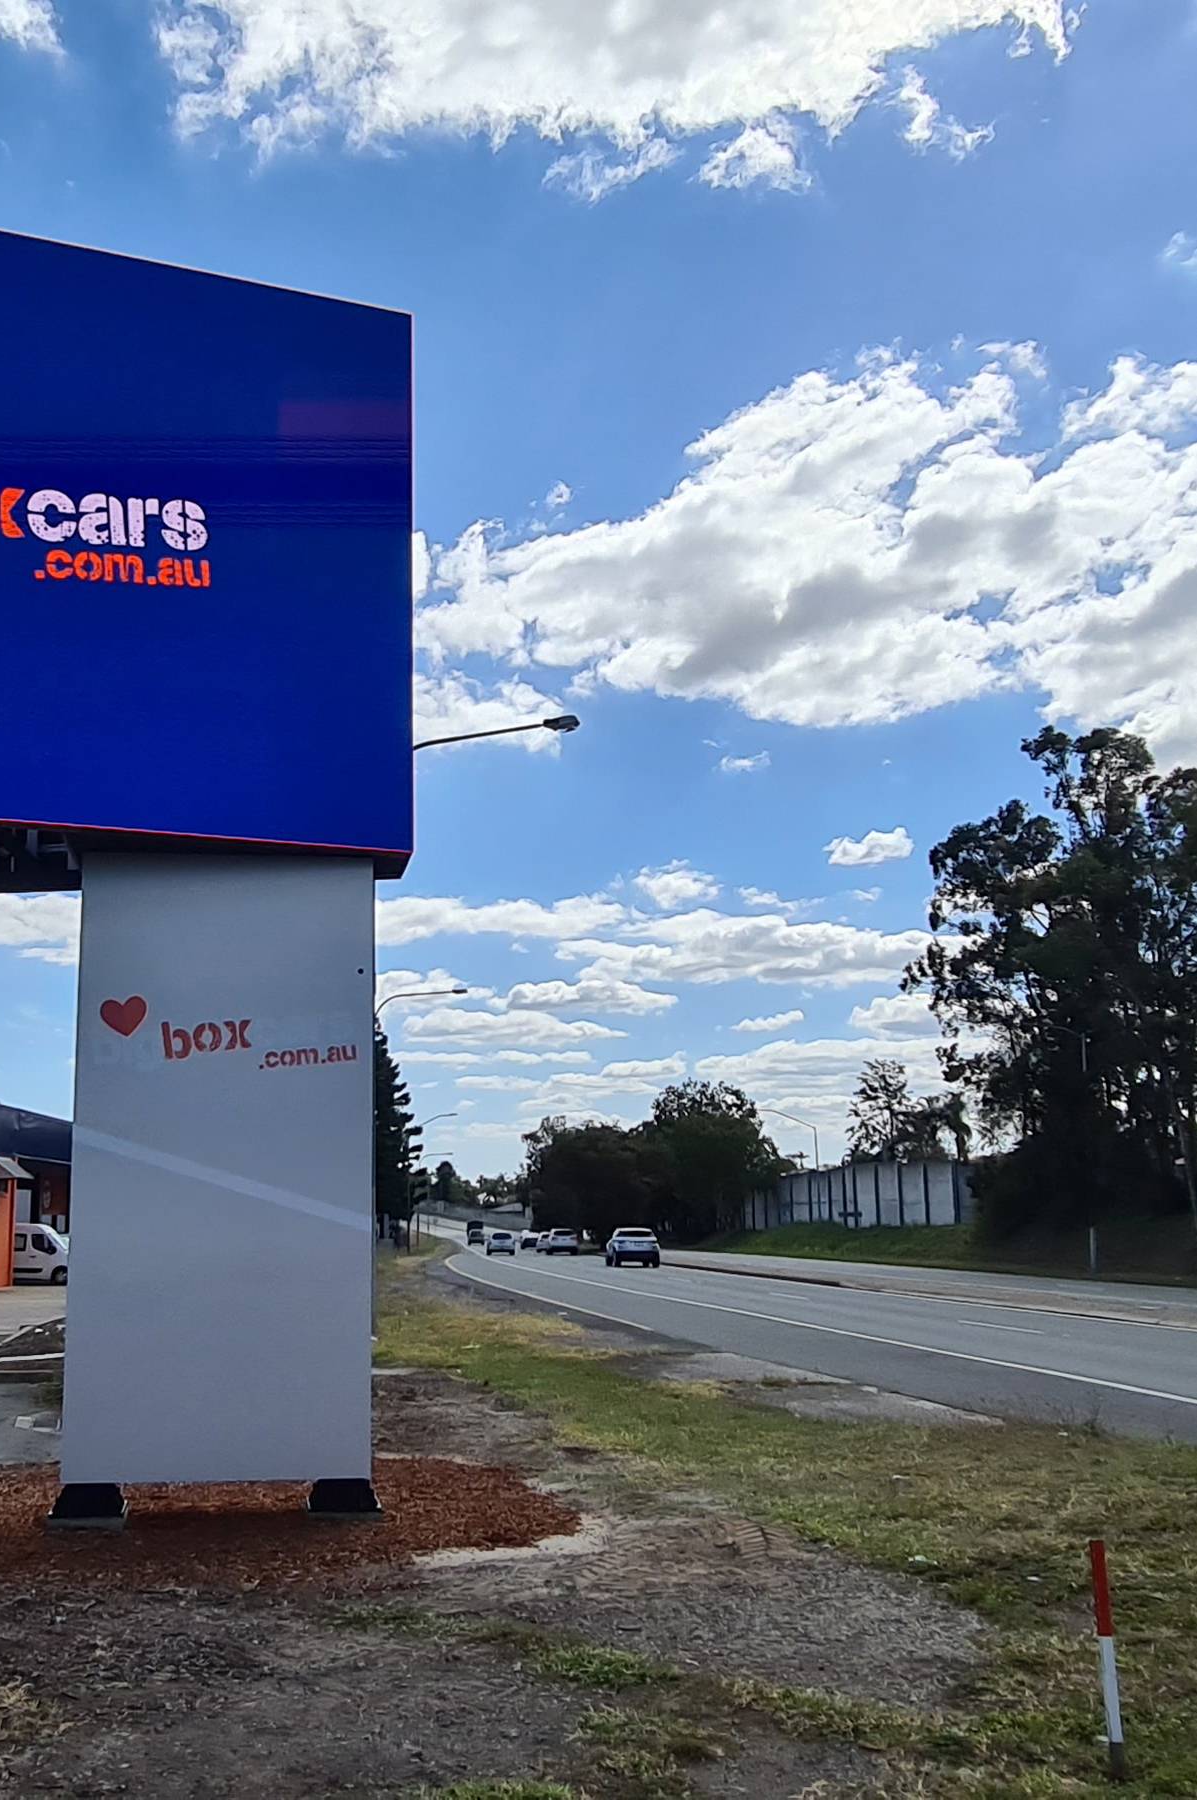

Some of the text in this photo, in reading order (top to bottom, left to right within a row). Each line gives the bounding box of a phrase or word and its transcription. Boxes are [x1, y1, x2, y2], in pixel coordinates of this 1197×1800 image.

[34, 549, 211, 588] .com.au
[160, 1018, 253, 1060] box
[258, 1044, 357, 1070] .com.au
